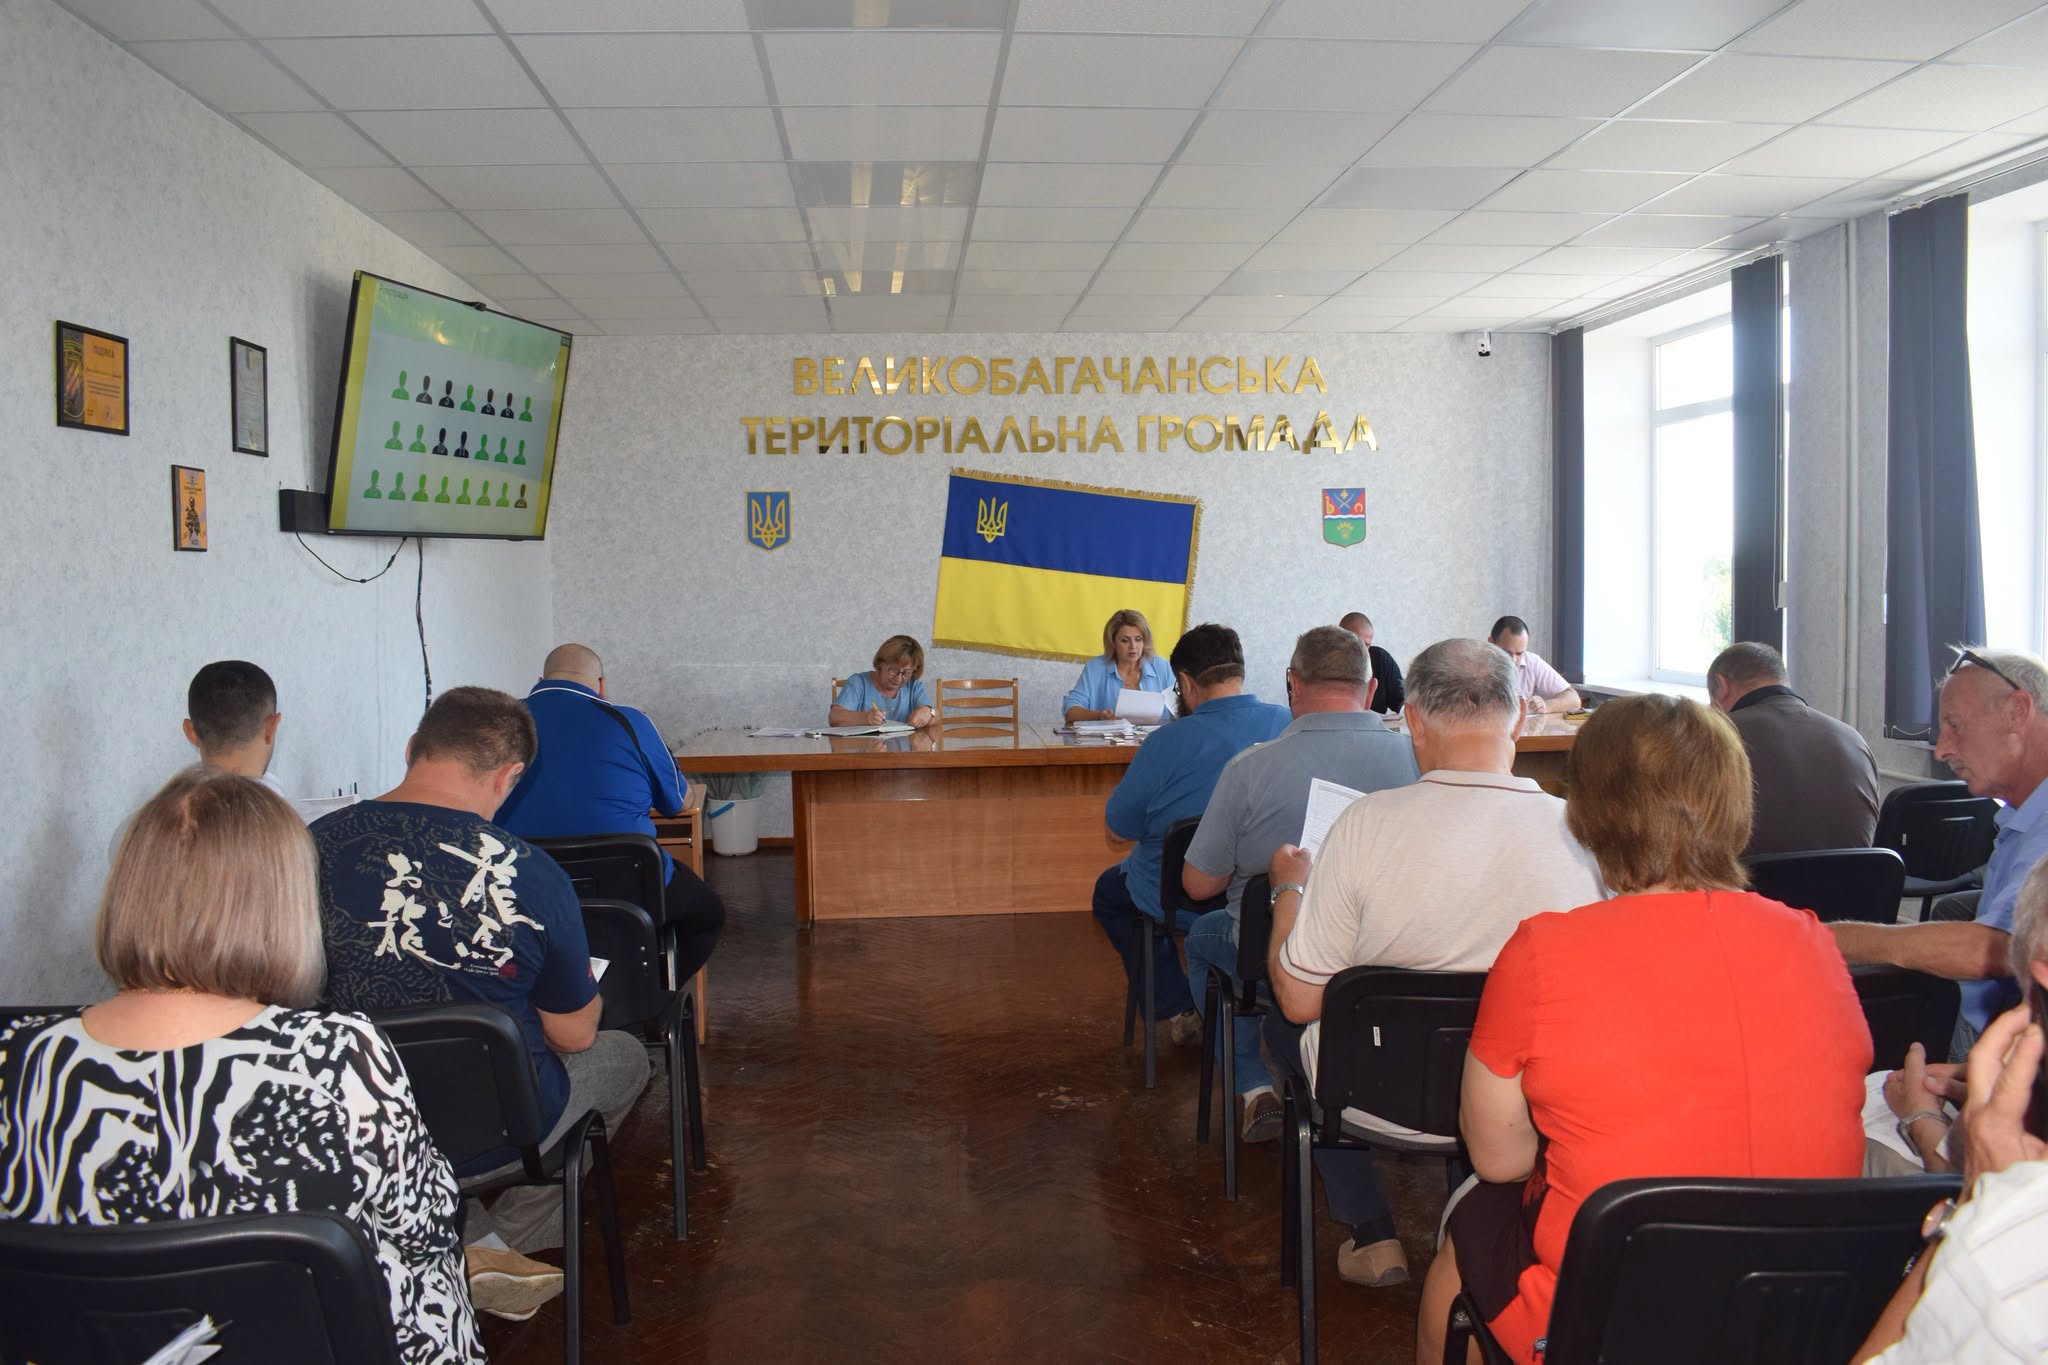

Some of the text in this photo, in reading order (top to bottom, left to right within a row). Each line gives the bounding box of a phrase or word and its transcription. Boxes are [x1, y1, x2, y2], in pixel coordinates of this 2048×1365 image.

[794, 355, 1328, 396] ВЕЛИКОБАГАЧАНСЬКА
[740, 410, 1379, 456] ТЕРИТОРІАЛЬНА ГРОМАДА
